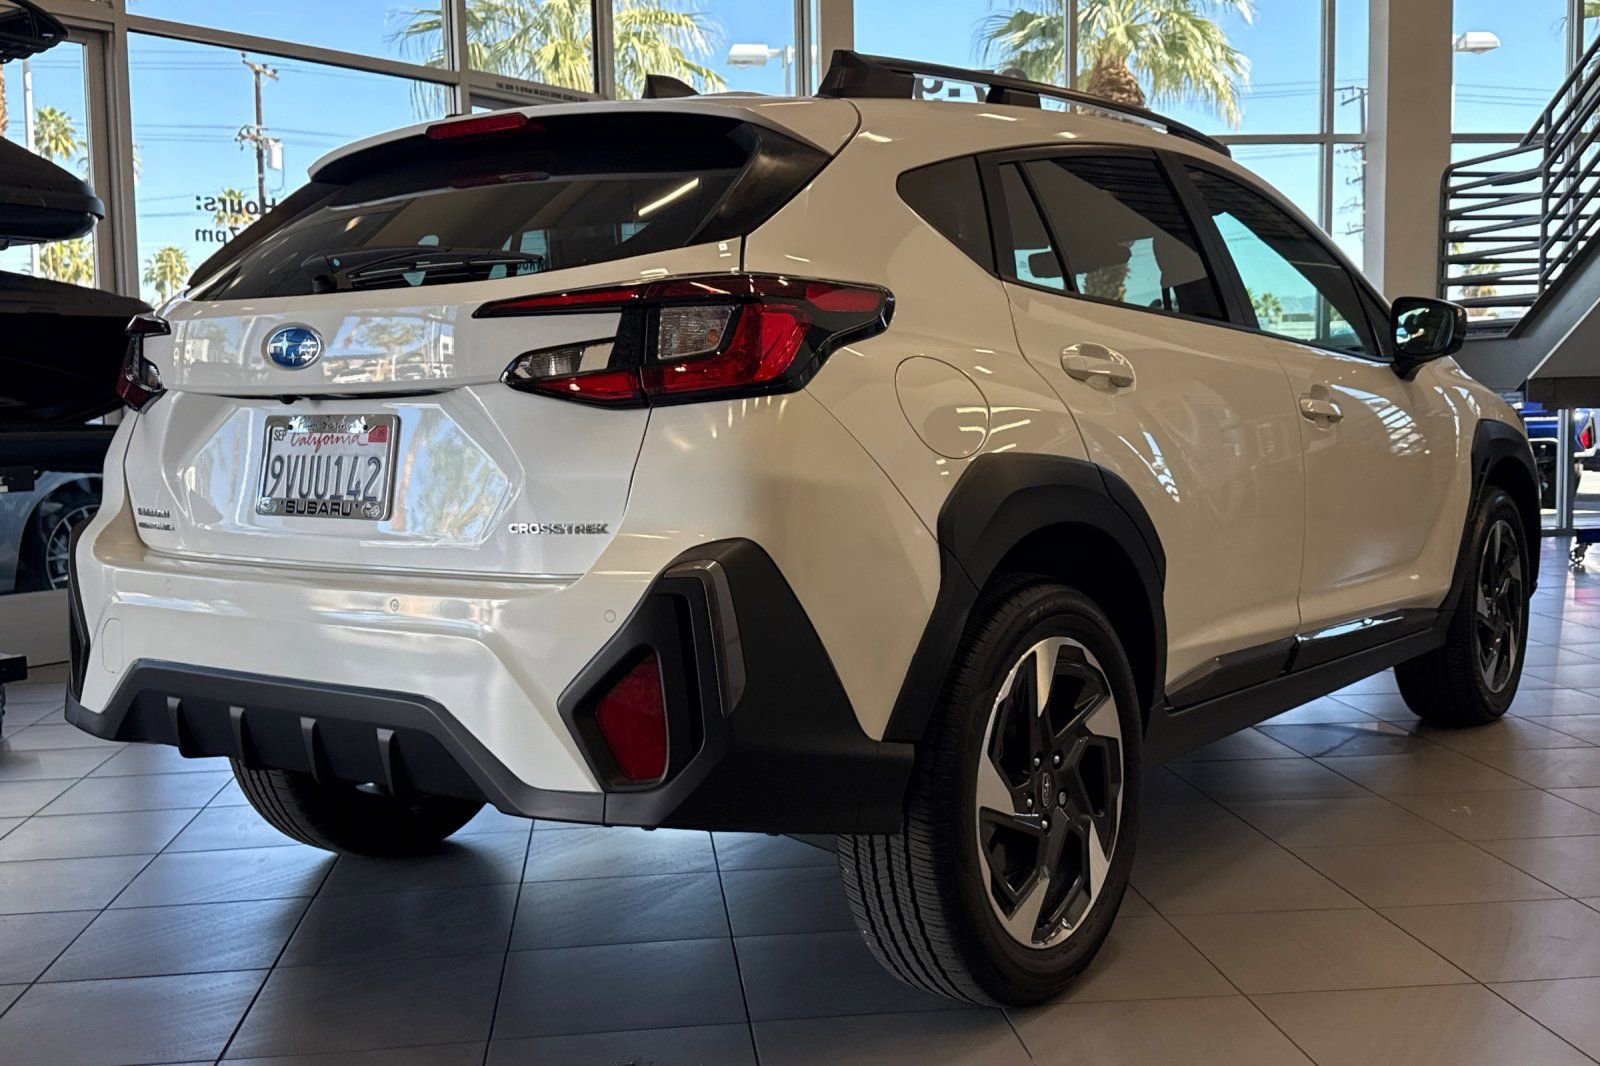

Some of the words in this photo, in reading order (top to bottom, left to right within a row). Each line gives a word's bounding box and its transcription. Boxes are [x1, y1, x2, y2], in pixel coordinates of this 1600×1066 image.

[274, 428, 287, 442] SEP
[290, 431, 369, 453] California
[266, 454, 381, 501] 9VUU142
[285, 501, 351, 516] SUBARU
[508, 523, 610, 535] CROSSTREK
